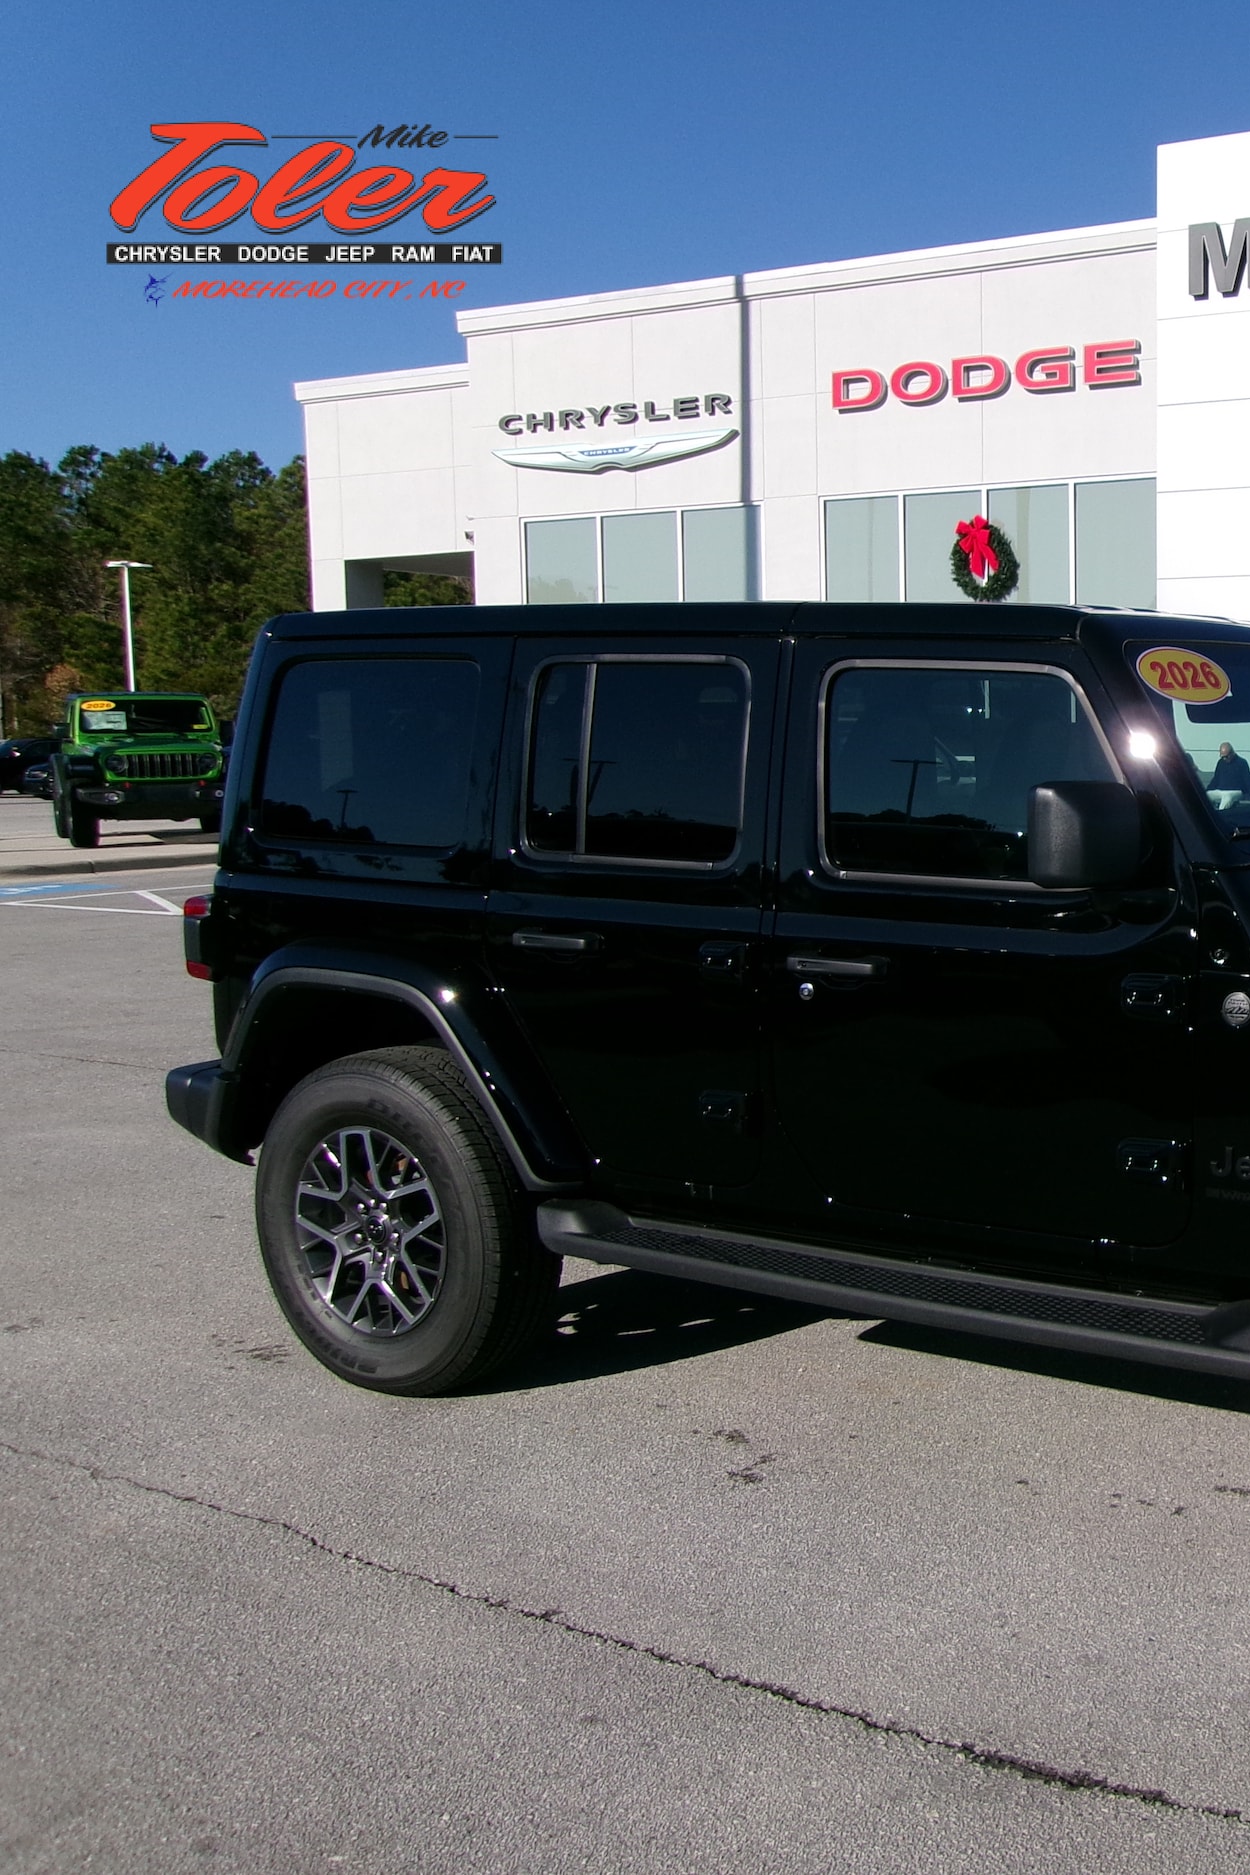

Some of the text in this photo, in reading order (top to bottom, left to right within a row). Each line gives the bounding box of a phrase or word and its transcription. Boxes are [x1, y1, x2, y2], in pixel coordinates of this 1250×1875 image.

[831, 338, 1142, 414] DODGE
[497, 392, 734, 436] CHRYSLER
[583, 447, 631, 456] CHRYSLER
[1150, 660, 1222, 690] 2026
